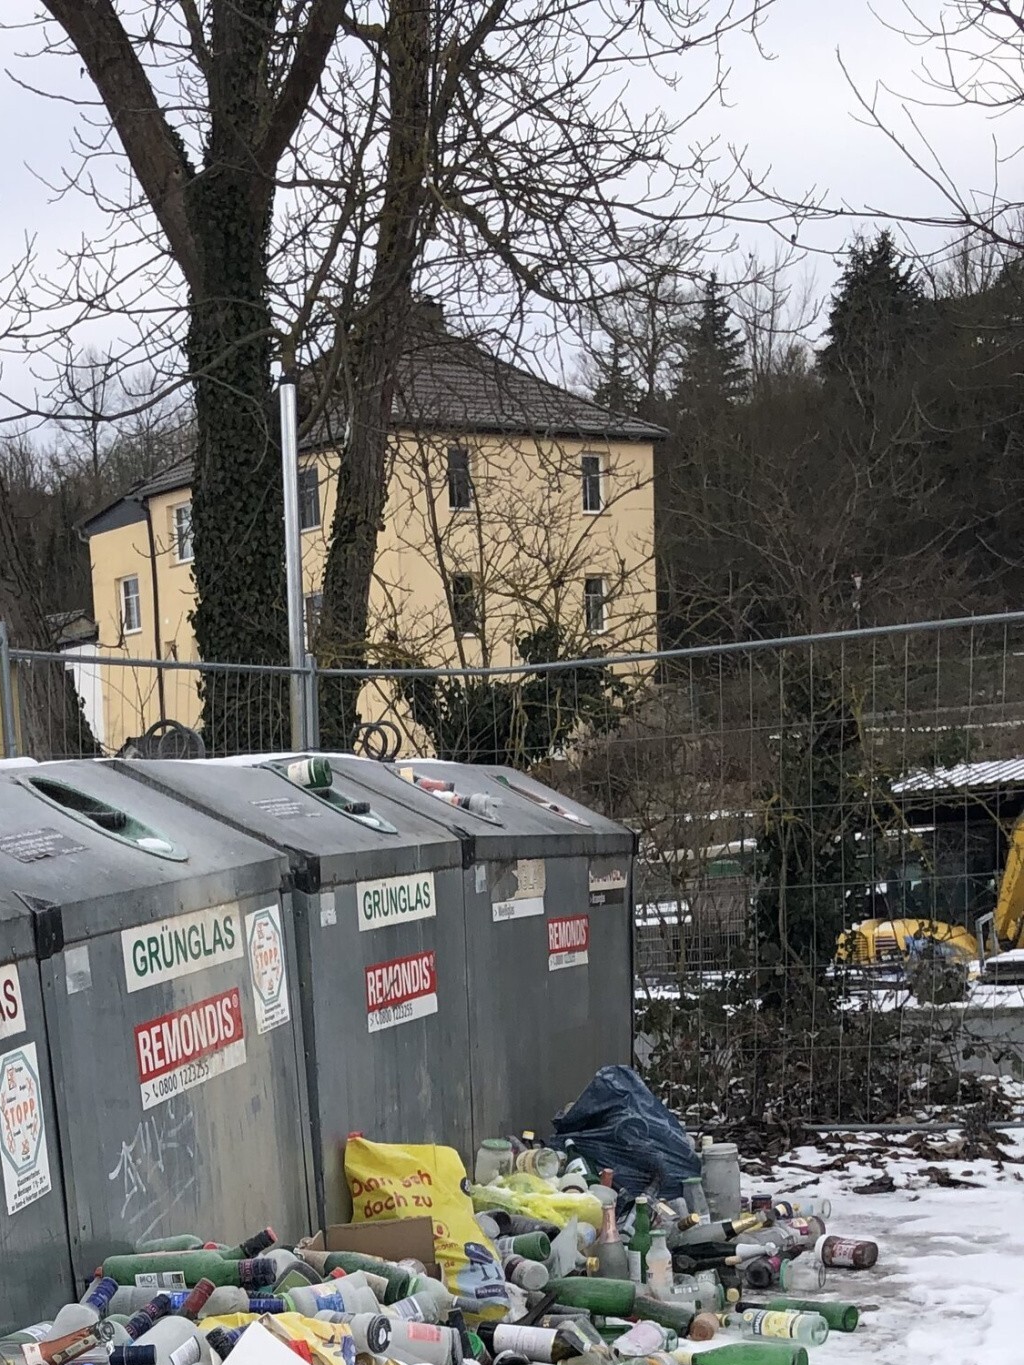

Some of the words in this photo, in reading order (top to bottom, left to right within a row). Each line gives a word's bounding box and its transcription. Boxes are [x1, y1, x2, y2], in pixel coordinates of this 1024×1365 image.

[362, 880, 431, 920] GRÜNGLAS
[132, 915, 236, 977] GRÜNGLAS
[256, 947, 279, 971] STOPP
[158, 1074, 179, 1098] 0800
[179, 1061, 211, 1088] 1223255
[4, 1097, 36, 1131] STOPP
[363, 1191, 409, 1219] doch
[411, 1194, 434, 1208] zu
